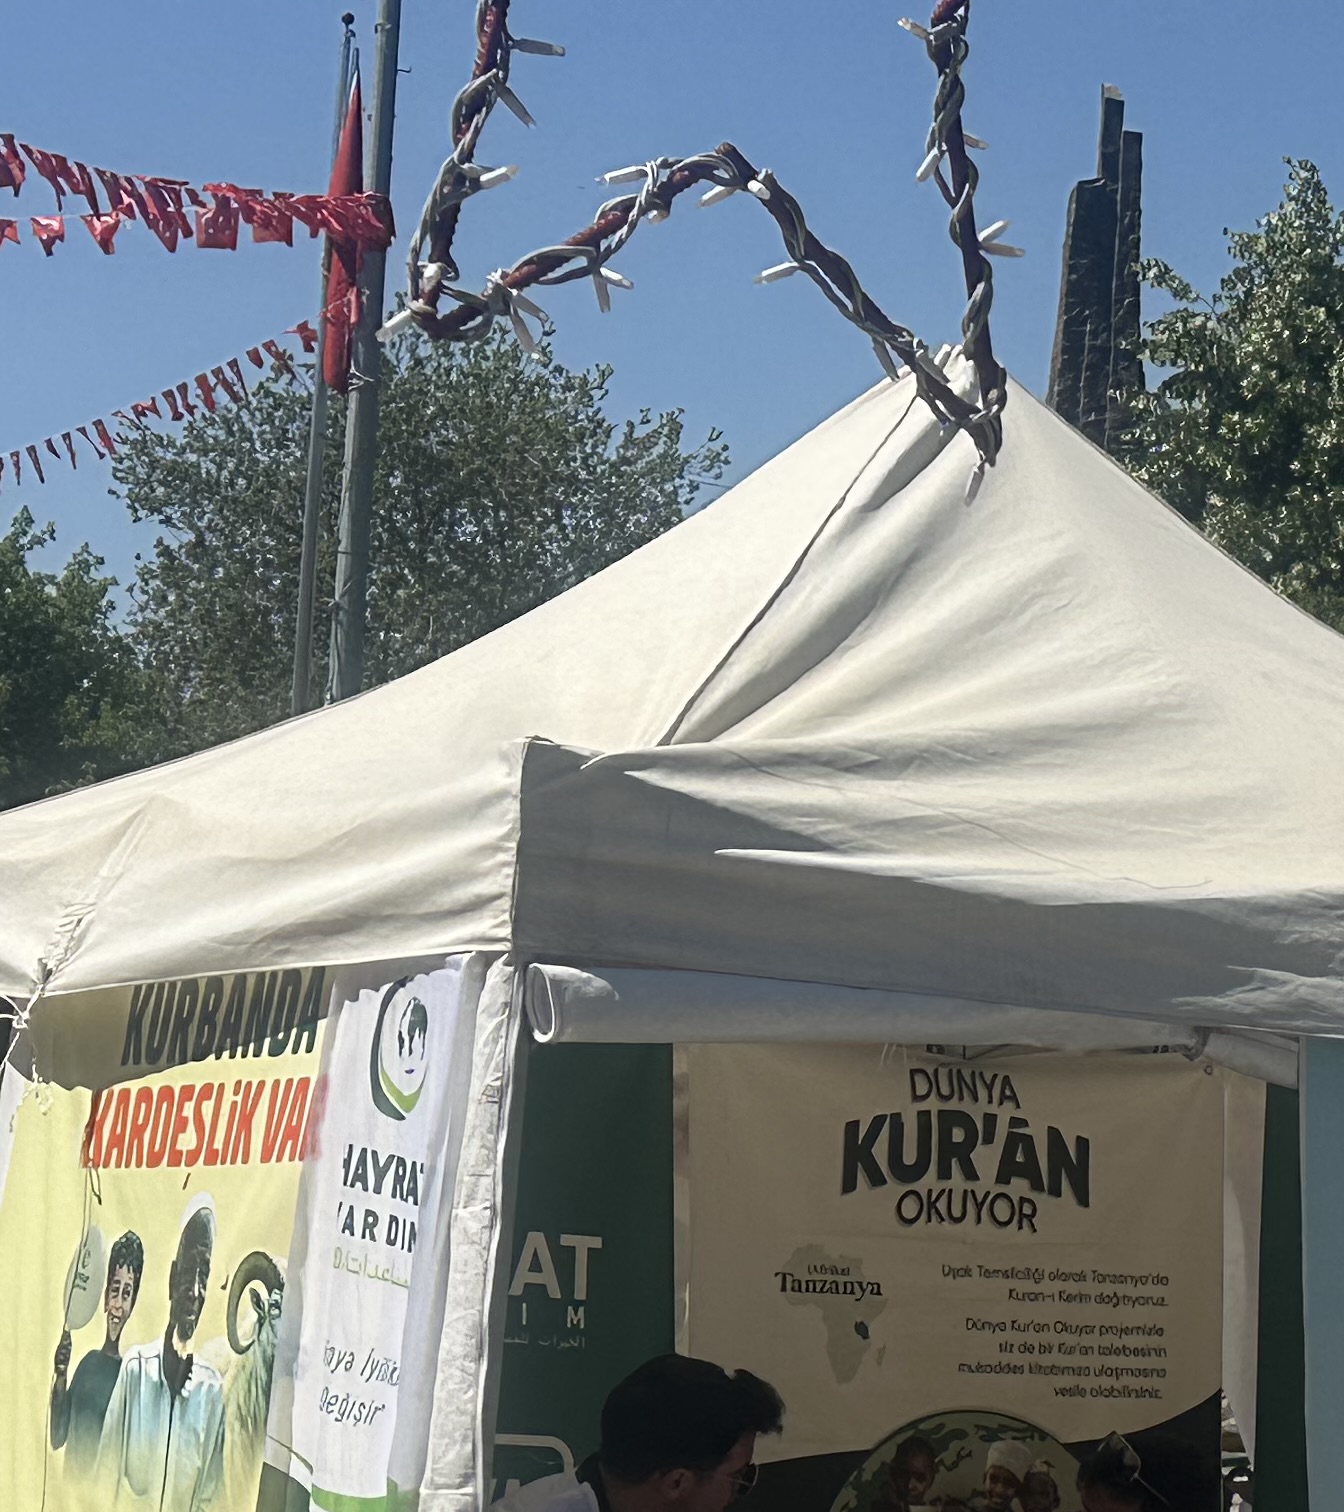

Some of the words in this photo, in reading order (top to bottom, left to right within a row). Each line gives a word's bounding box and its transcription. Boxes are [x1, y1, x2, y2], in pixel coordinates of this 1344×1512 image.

[120, 965, 326, 1067] KURBANDA
[909, 1063, 1021, 1110] DÜNYA
[895, 1187, 1038, 1234] OKUYOR
[773, 1271, 883, 1302] Tanzanya
